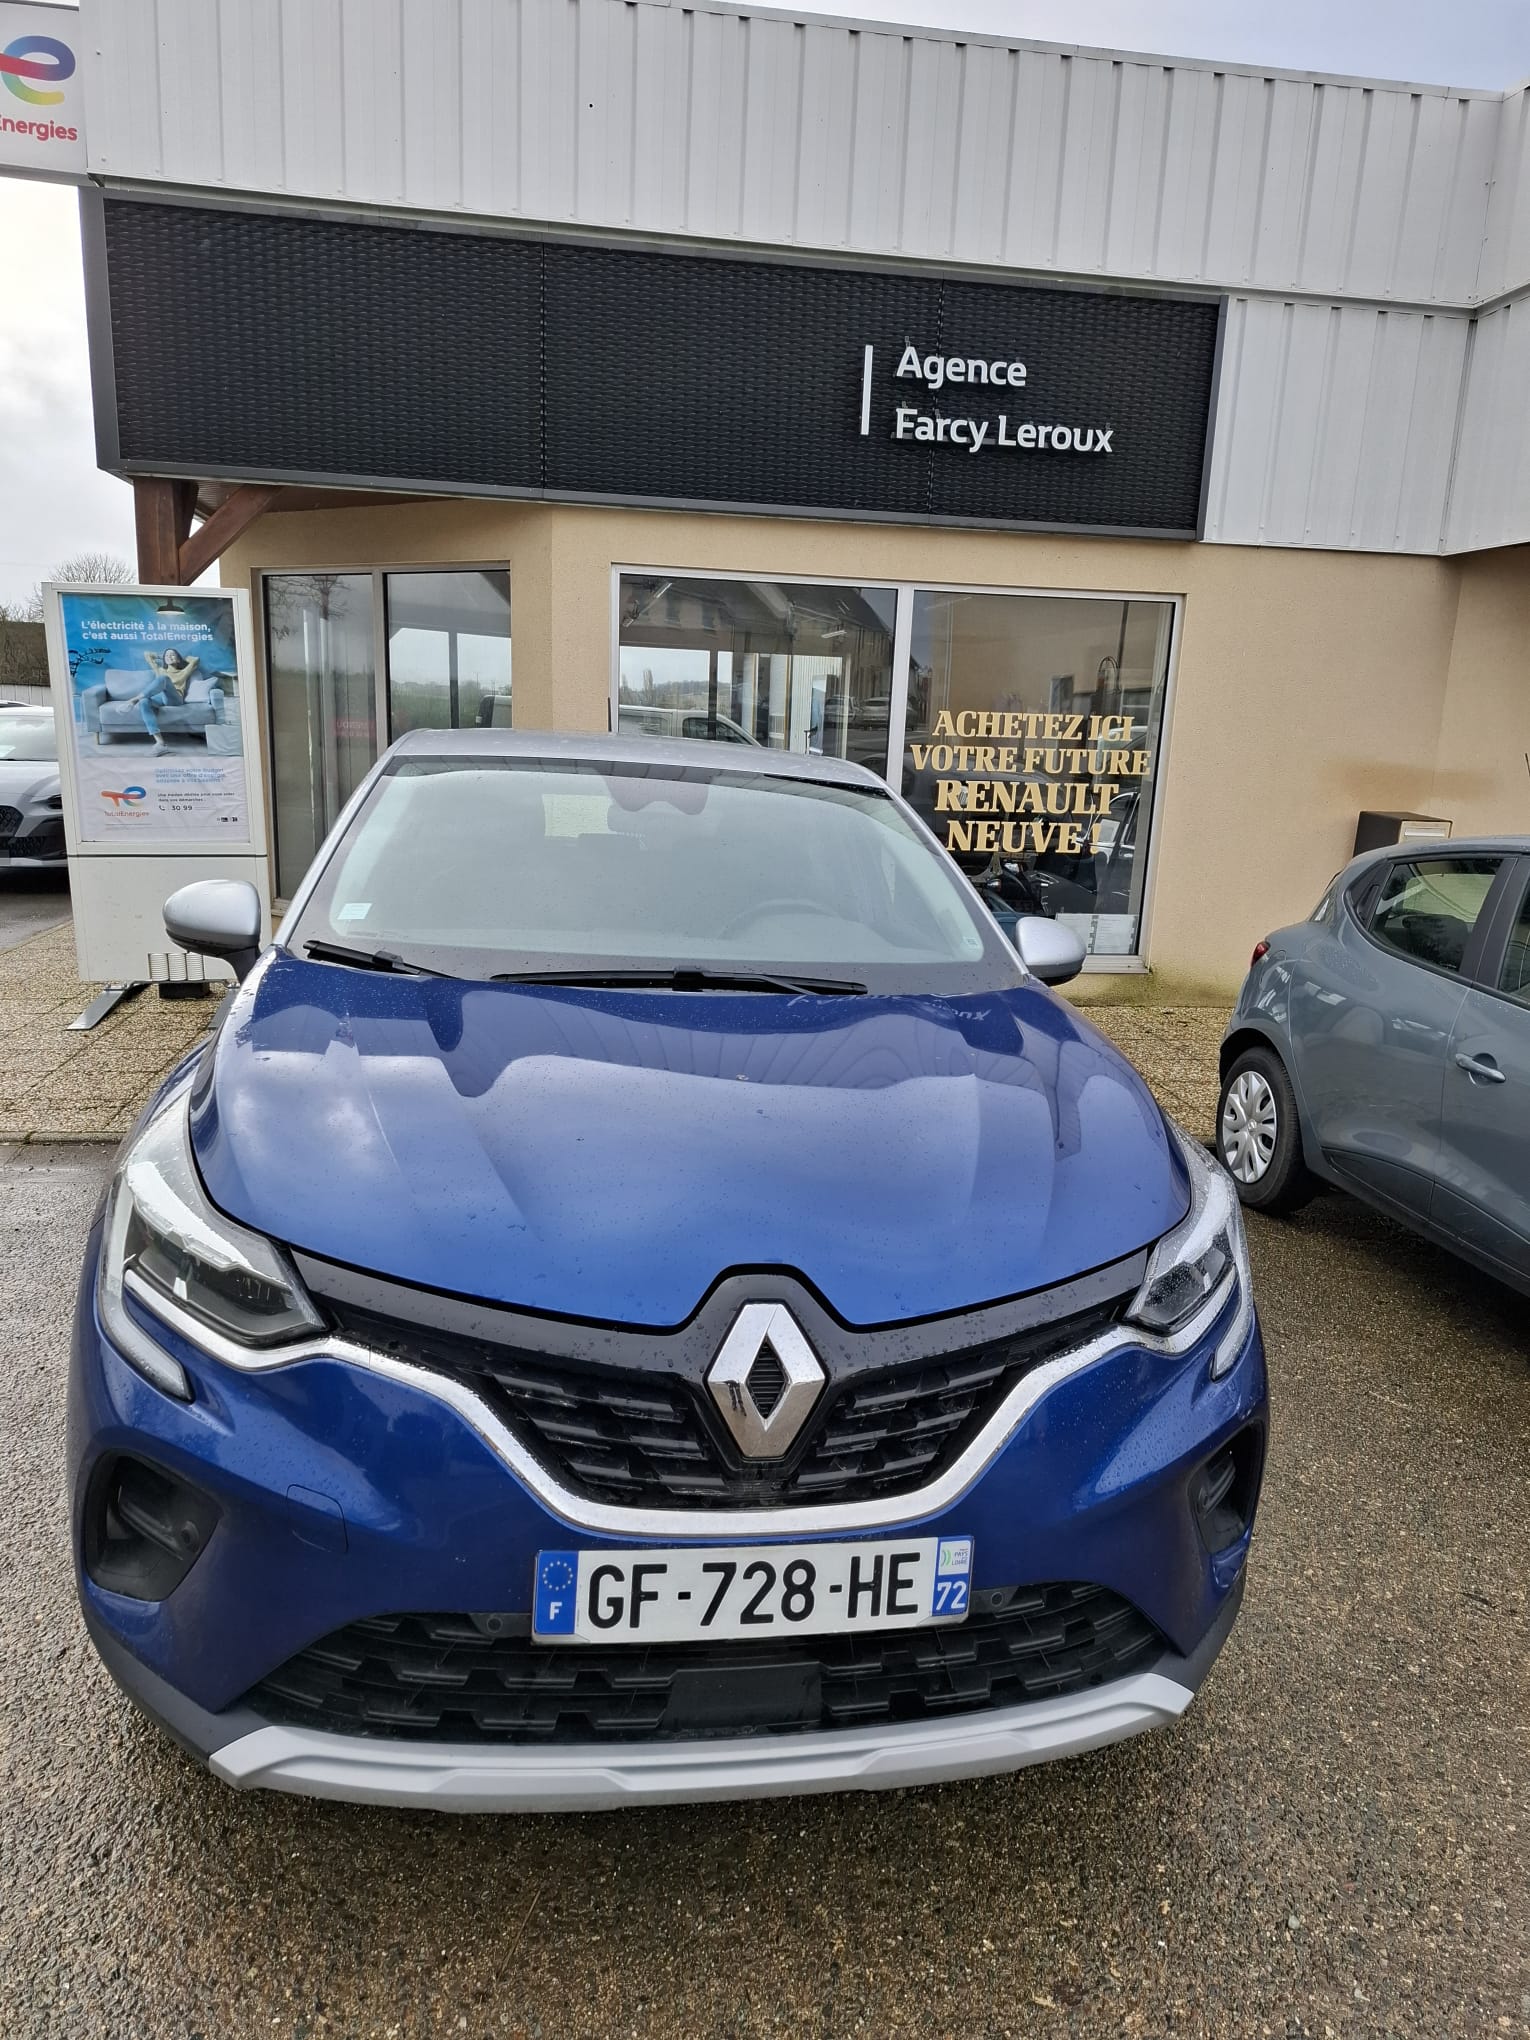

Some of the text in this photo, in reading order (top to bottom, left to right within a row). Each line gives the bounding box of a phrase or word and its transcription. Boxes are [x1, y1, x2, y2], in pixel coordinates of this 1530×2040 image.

[0, 114, 78, 141] nergies
[896, 345, 1027, 389] Agence
[895, 407, 1114, 453] Farcy Leroux
[82, 631, 214, 642] c'est aussi TotalEnergies
[147, 621, 154, 631] à
[157, 621, 167, 631] la
[169, 622, 211, 633] maison,
[932, 710, 1134, 742] ACHETEZ ICI
[910, 745, 1152, 776] VOTRE FUTURE
[934, 780, 1119, 815] RENAULT
[947, 820, 1083, 854] NEUVE
[588, 1552, 921, 1629] GF-728-HE
[936, 1580, 967, 1611] 72
[549, 1602, 562, 1621] F
